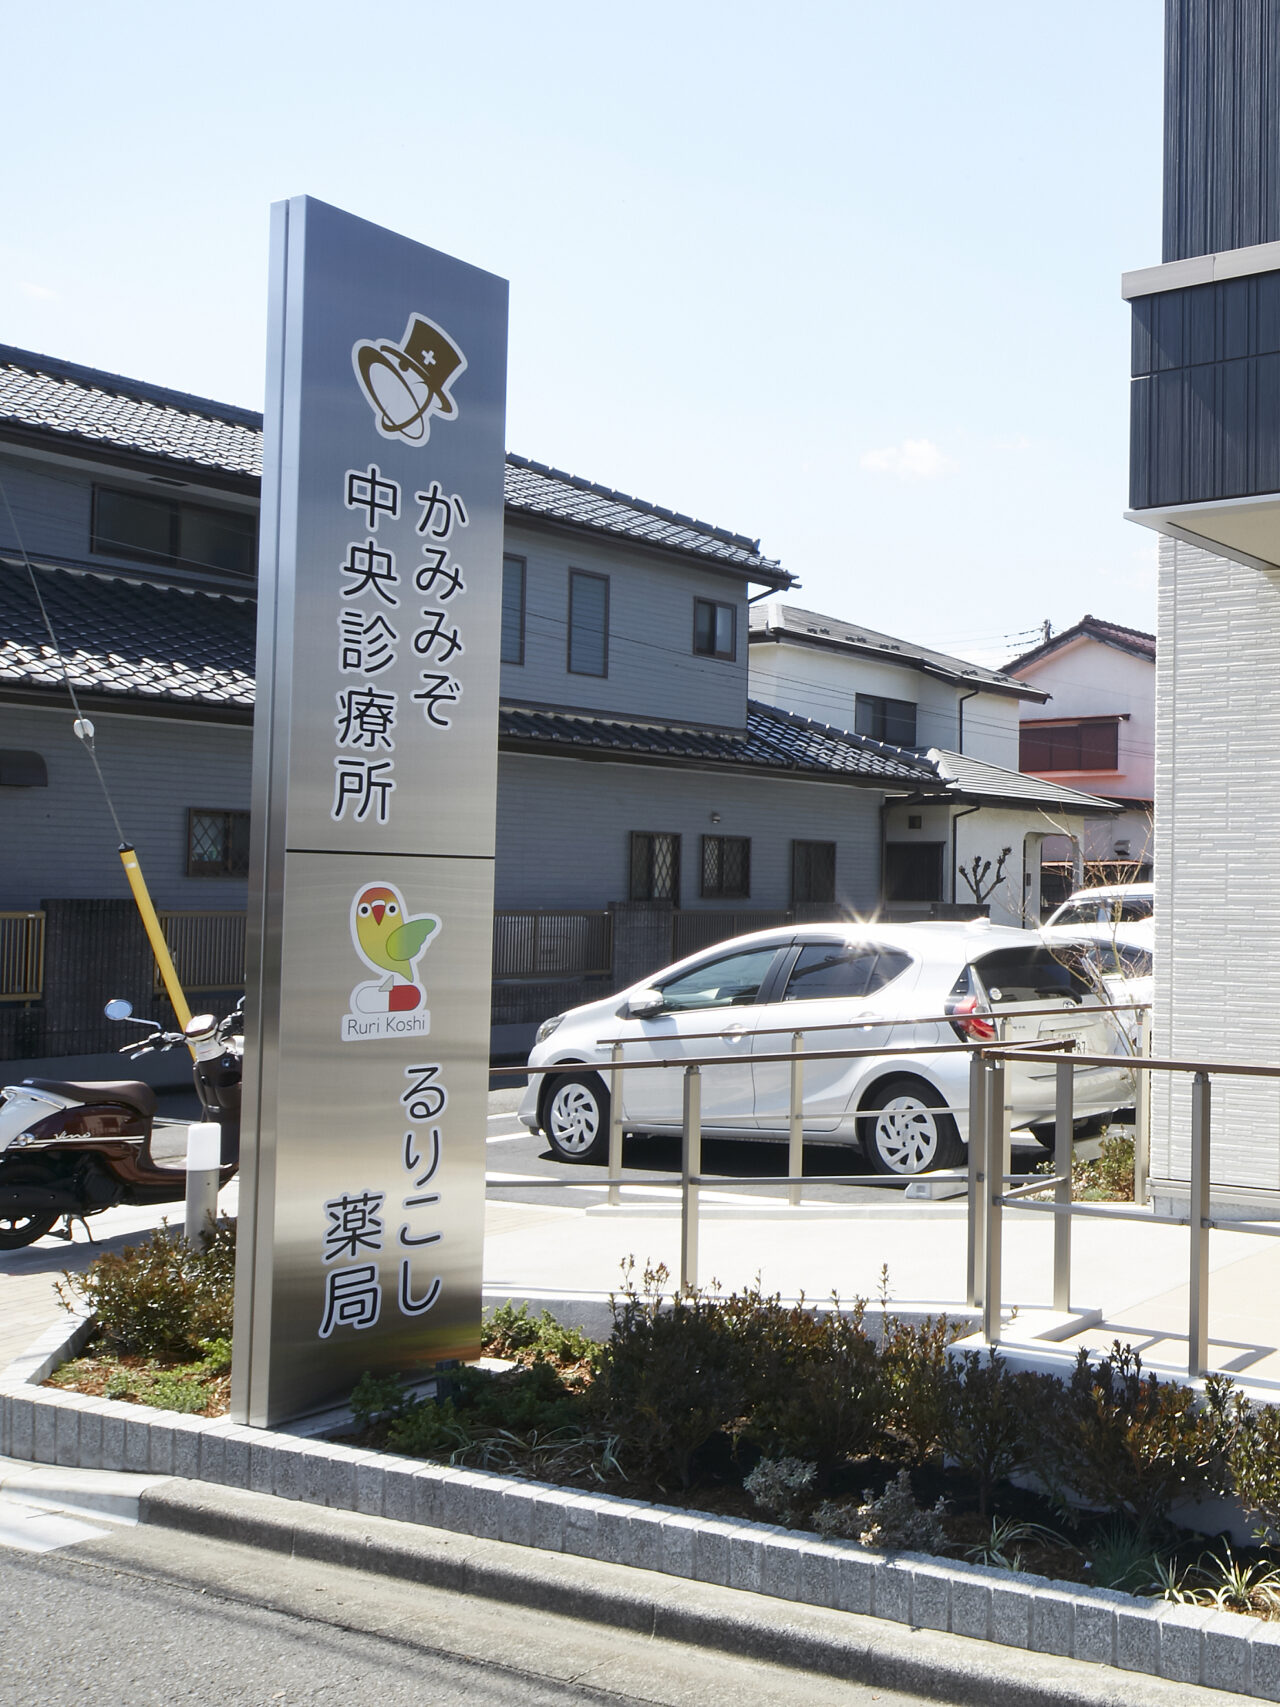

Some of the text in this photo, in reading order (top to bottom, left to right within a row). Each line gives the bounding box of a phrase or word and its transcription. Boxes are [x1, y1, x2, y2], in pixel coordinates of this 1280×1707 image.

[335, 467, 399, 822] 中央診療所
[414, 484, 467, 728] かみみぞ
[347, 1014, 425, 1036] Ruri Koshi
[321, 1192, 386, 1337] 薬局
[401, 1065, 447, 1314] るりこし
